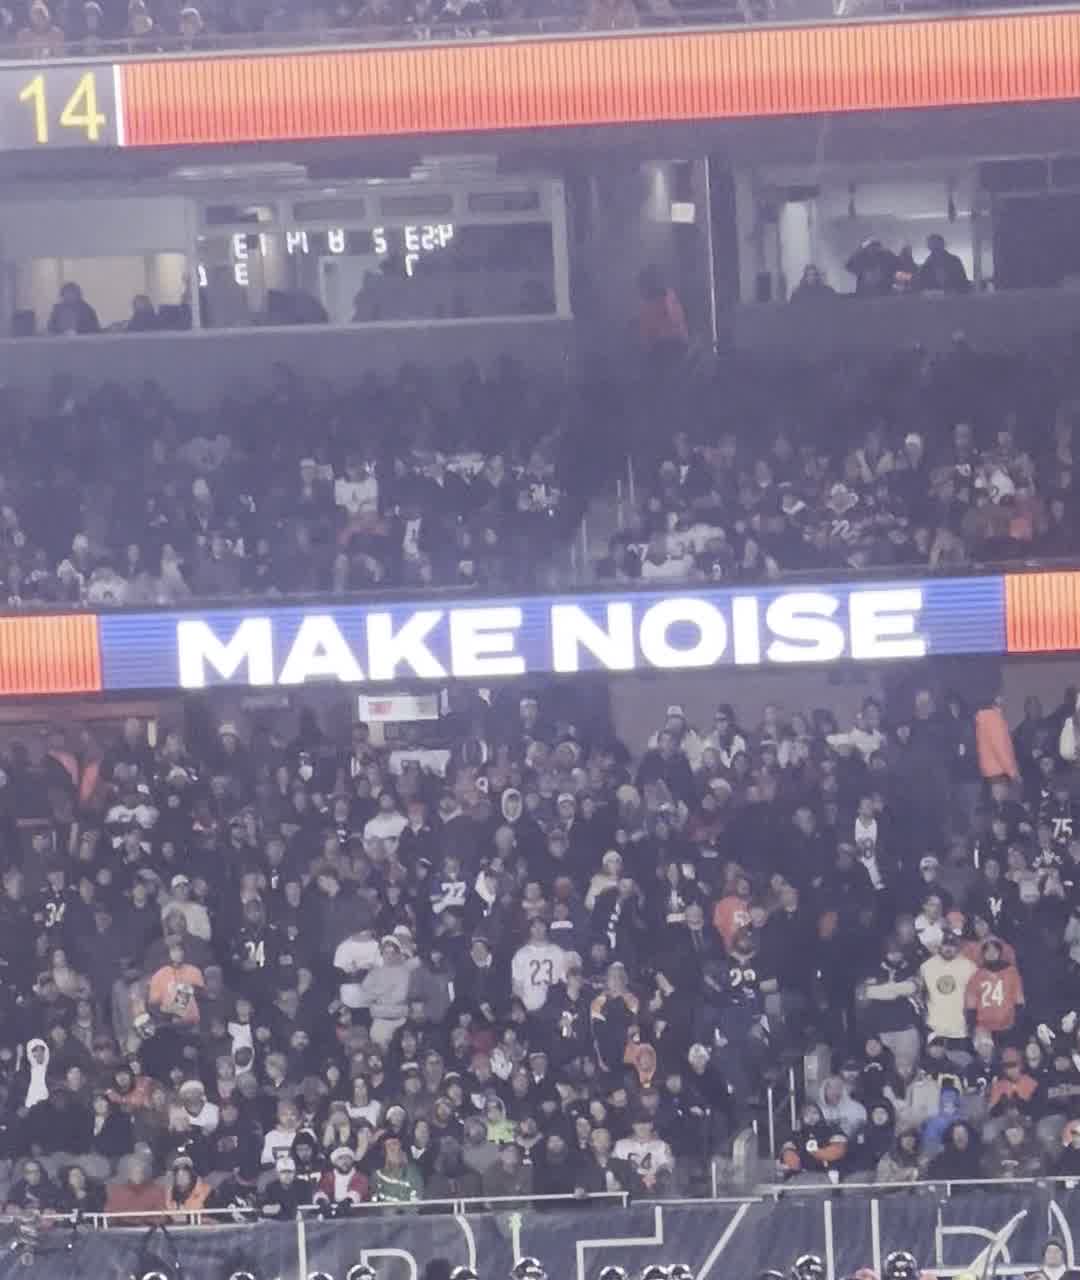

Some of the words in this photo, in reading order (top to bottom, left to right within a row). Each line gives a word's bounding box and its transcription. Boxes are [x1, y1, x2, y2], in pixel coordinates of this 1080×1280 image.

[19, 71, 106, 145] 14
[177, 609, 524, 689] MAKE
[551, 589, 926, 675] NOISE
[529, 959, 554, 986] 23
[980, 979, 1004, 1008] 24
